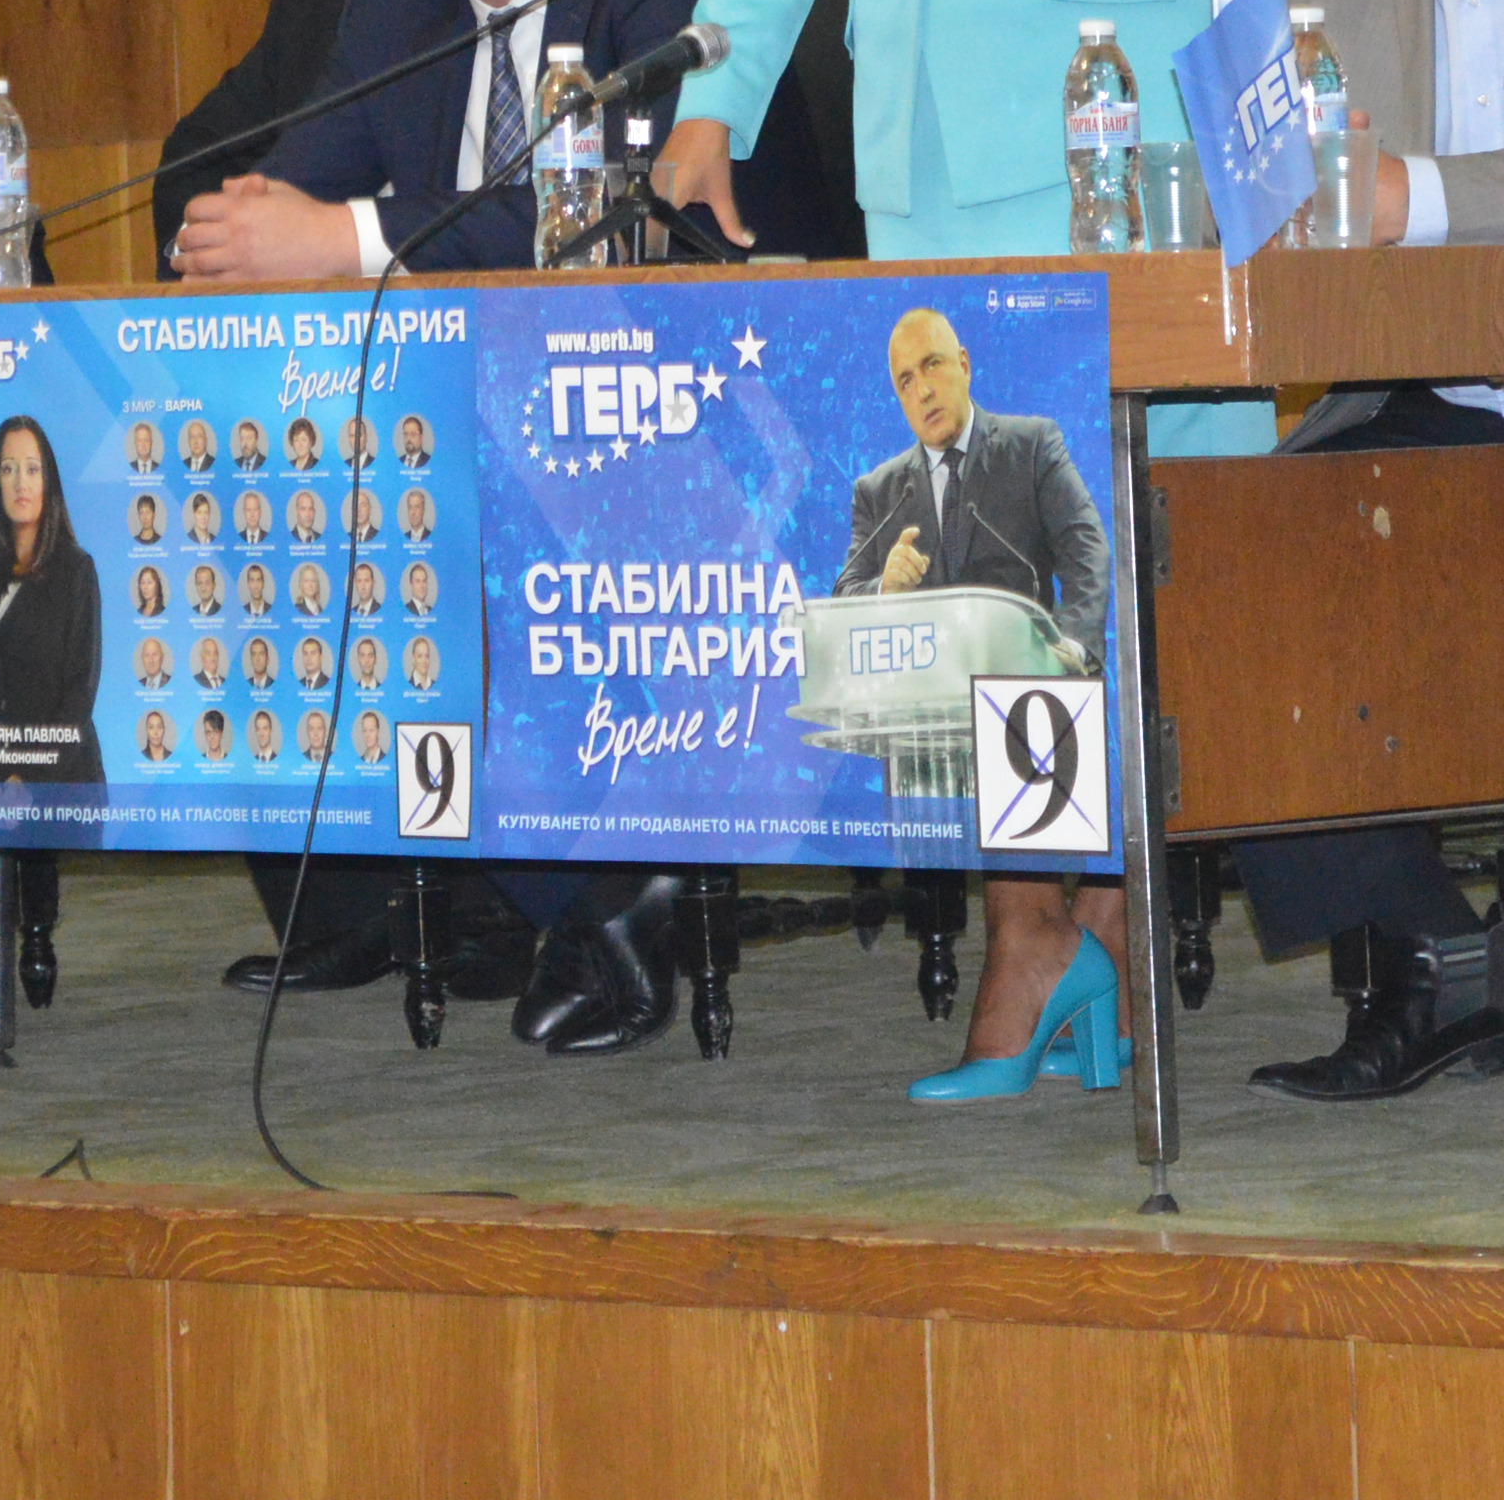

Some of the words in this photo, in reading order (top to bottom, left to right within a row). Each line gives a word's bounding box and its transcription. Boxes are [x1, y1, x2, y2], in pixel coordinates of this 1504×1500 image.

[1102, 116, 1128, 131] БАНЯ
[117, 315, 286, 353] СТАБИЛНА
[294, 310, 466, 347] БЪЛГАРИЯ
[546, 329, 654, 353] www.gerb.bg
[122, 400, 130, 412] 3
[132, 400, 157, 412] МИР
[165, 399, 203, 412] ВАРНА
[551, 364, 698, 436] ГЕРБ
[524, 564, 805, 615] СТАБИЛНА
[528, 626, 805, 677] БЪЛГАРИЯ
[850, 622, 936, 674] ГЕРБ
[24, 728, 80, 744] ПАВЛОВА
[579, 682, 702, 785] Време
[717, 684, 760, 750] е!
[414, 731, 456, 831] 9
[1004, 689, 1079, 840] 9
[44, 808, 53, 821] И
[56, 807, 157, 824] ПРОДАВАНЕТО
[161, 808, 180, 822] НА
[185, 808, 249, 823] ГЛАСОВЕ
[251, 809, 260, 823] Е
[498, 814, 600, 830] КУПУВАНЕТО
[605, 816, 615, 831] И
[620, 817, 730, 834] ПРОДАВАНЕТО
[735, 819, 756, 833] НА
[760, 819, 828, 835] ГЛАСОВЕ
[832, 821, 840, 835] Е
[844, 821, 963, 839] ПРЕСТЪПЛЕНИЕ
